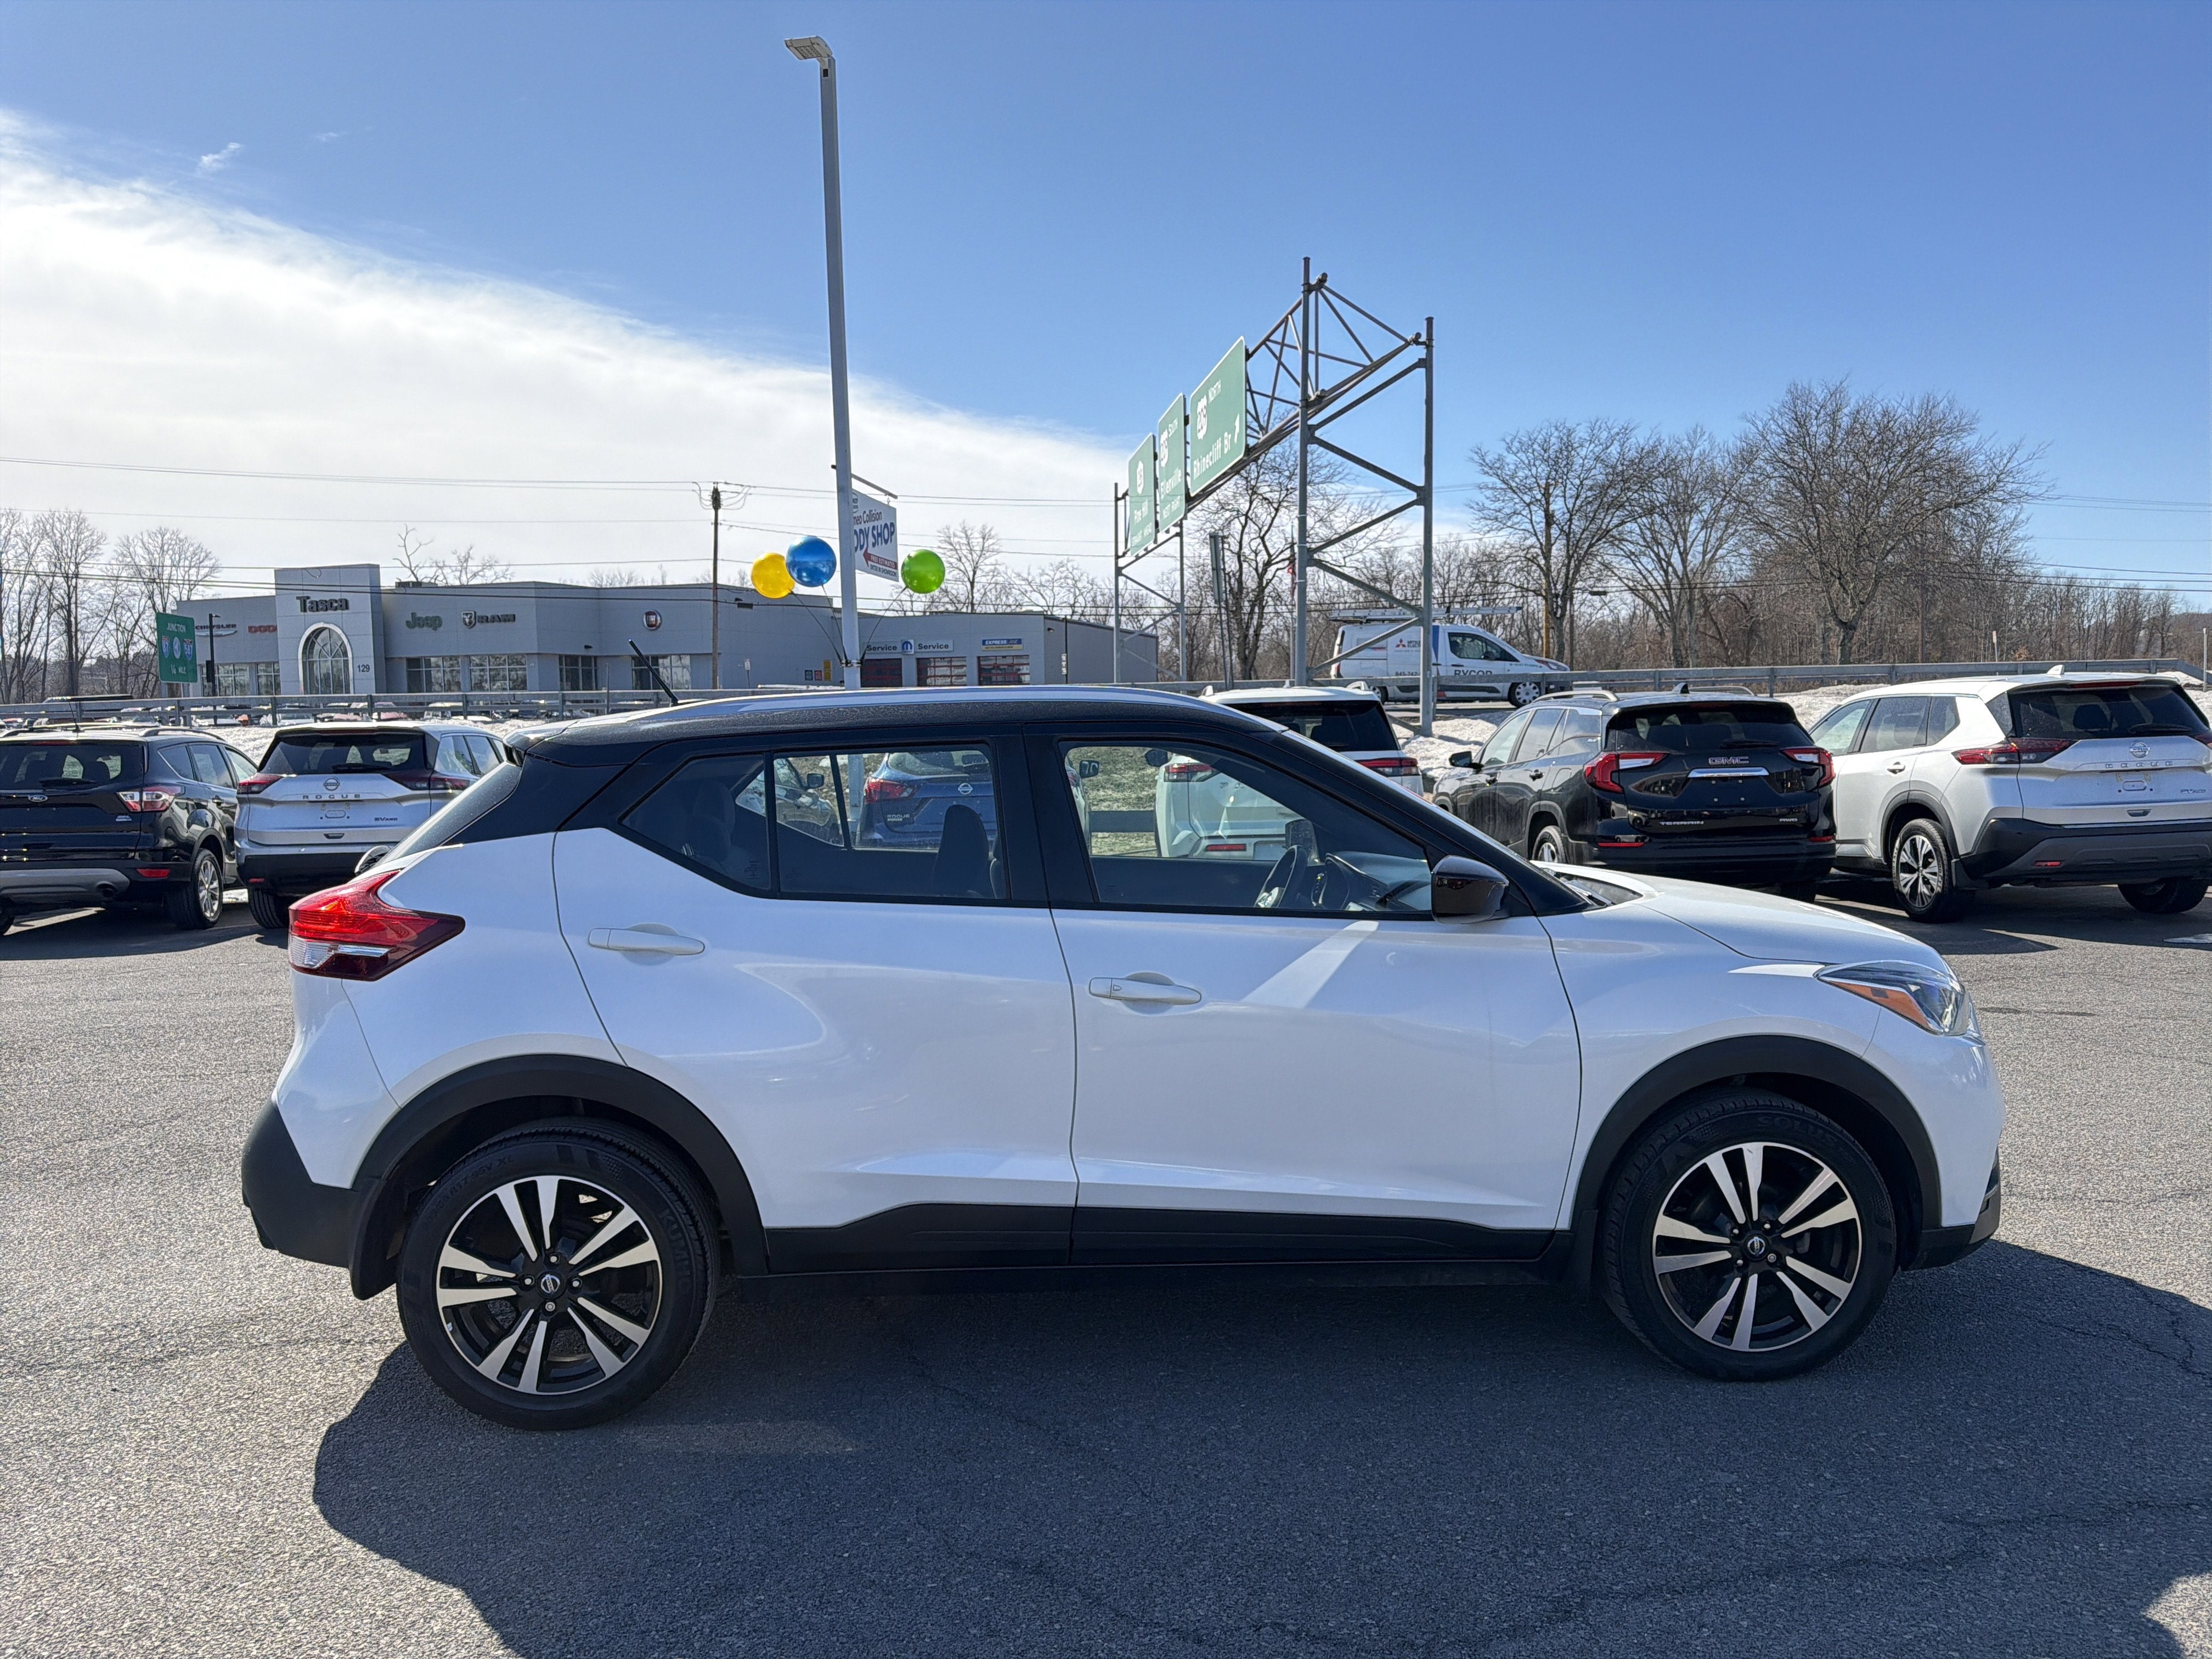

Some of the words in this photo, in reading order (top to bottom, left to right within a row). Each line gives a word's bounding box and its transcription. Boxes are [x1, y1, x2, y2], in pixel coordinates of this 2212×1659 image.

[1224, 431, 1231, 454] Br
[863, 509, 882, 524] Collision
[872, 522, 895, 548] SHOP
[878, 556, 895, 568] ESTIMATES
[296, 596, 349, 613] Tasca
[405, 612, 443, 631] Jeep
[477, 614, 516, 623] RAM
[357, 664, 370, 673] 129
[1708, 756, 1749, 765] GMC
